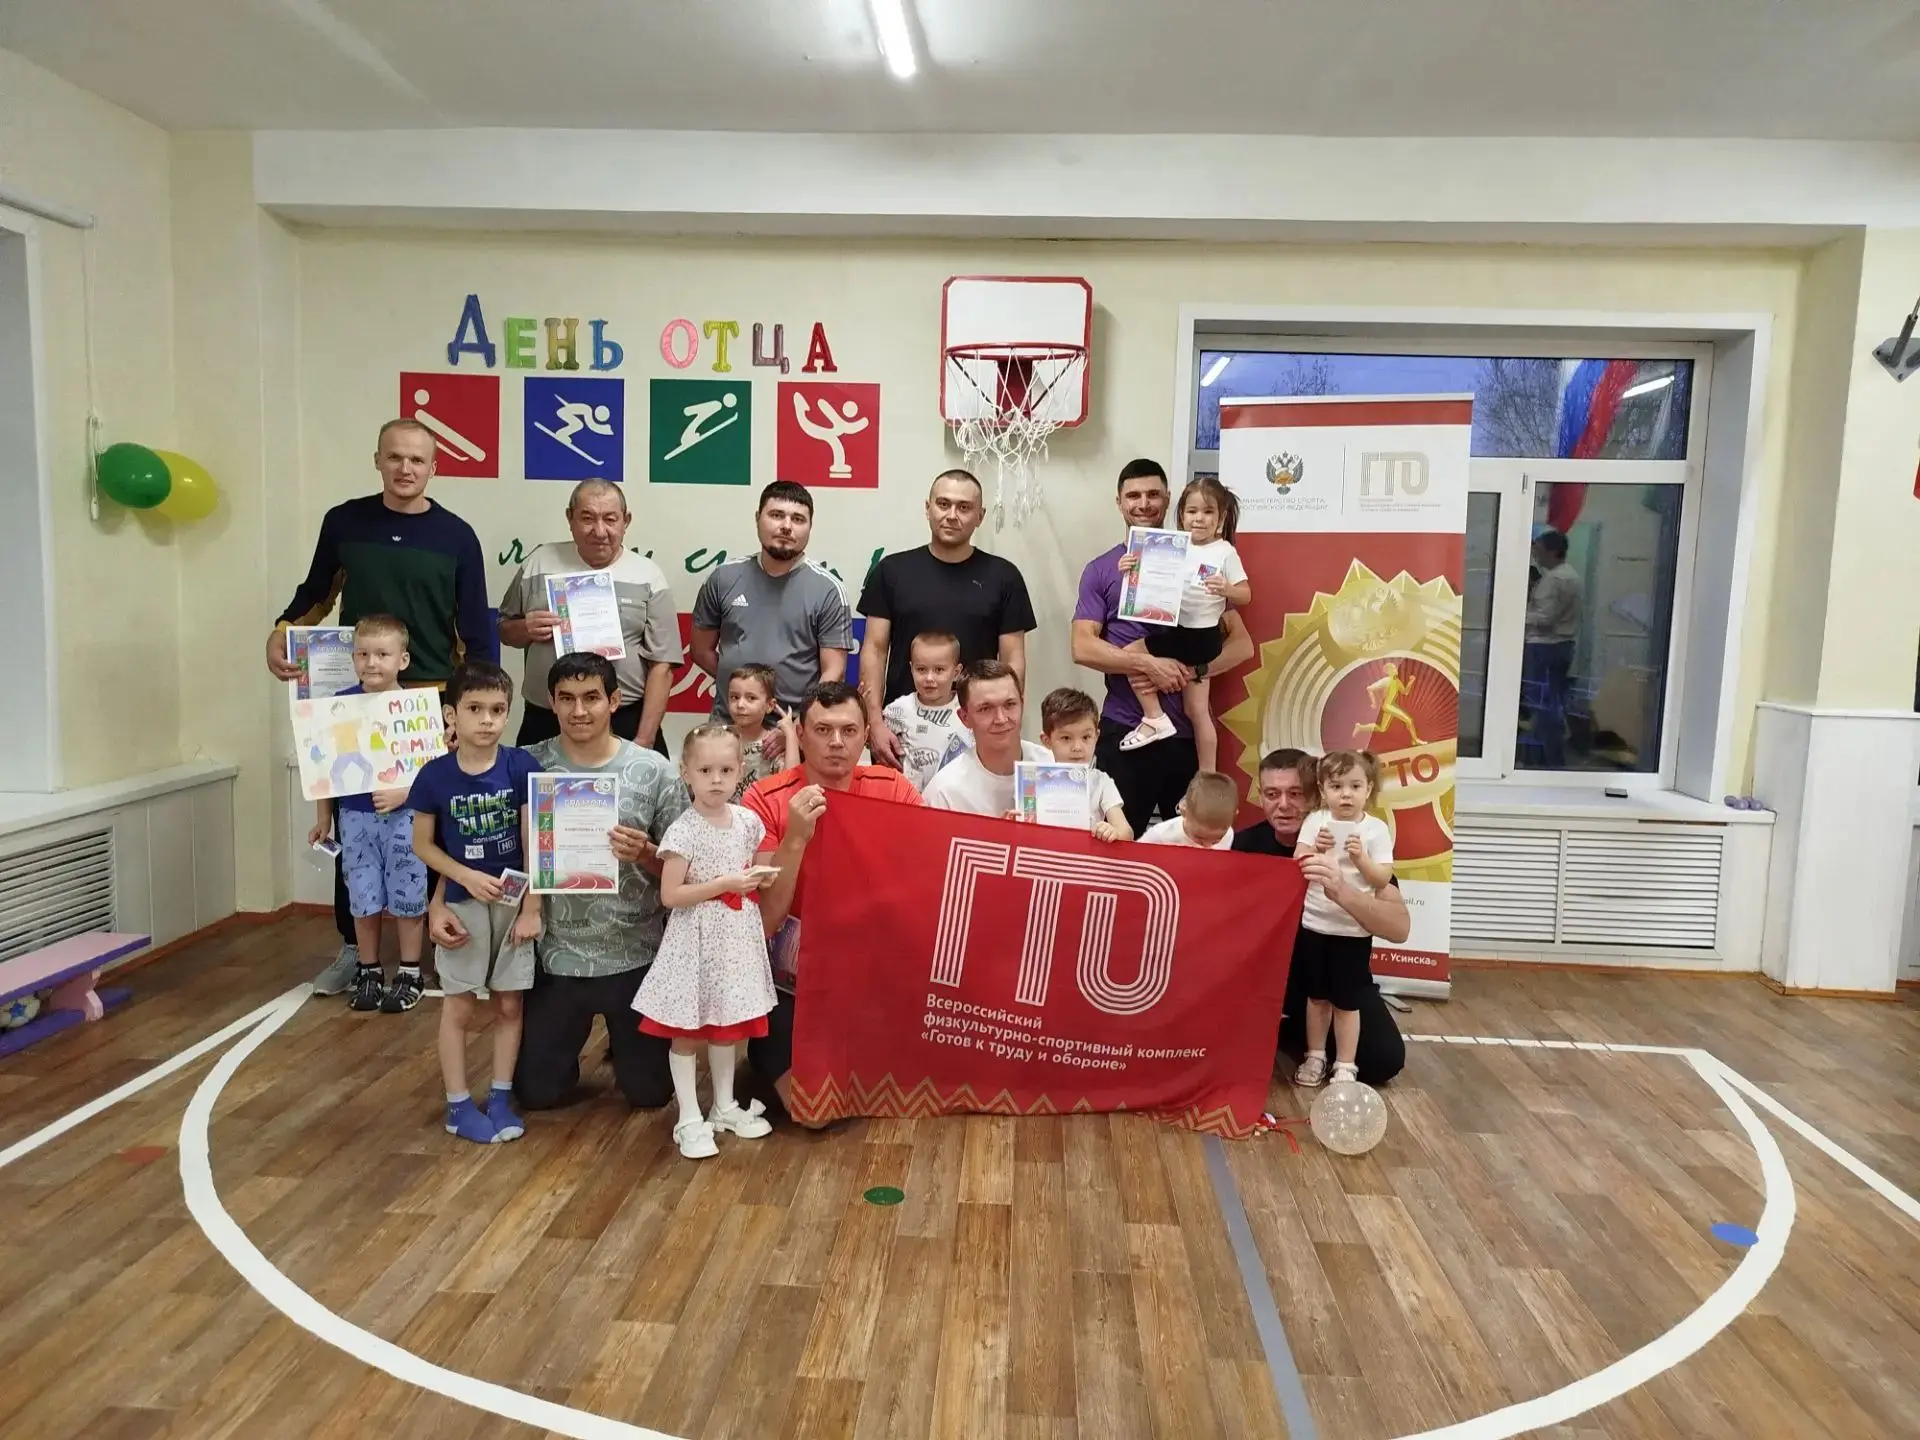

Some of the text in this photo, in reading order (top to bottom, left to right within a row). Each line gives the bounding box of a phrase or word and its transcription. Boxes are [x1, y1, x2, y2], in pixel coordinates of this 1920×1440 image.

[447, 294, 838, 374] ДЕНЬ ОТЦА
[1360, 451, 1430, 496] ГТО
[388, 693, 429, 715] МОЙ
[393, 716, 440, 734] ПАПА
[1380, 753, 1440, 787] ТО
[930, 836, 1180, 1015] ГТО
[926, 993, 1042, 1029] Всероссийский
[920, 1028, 1127, 1071] «Готов к труду и обороне»
[923, 1011, 1207, 1059] физкультурно-спортивный комплекс
